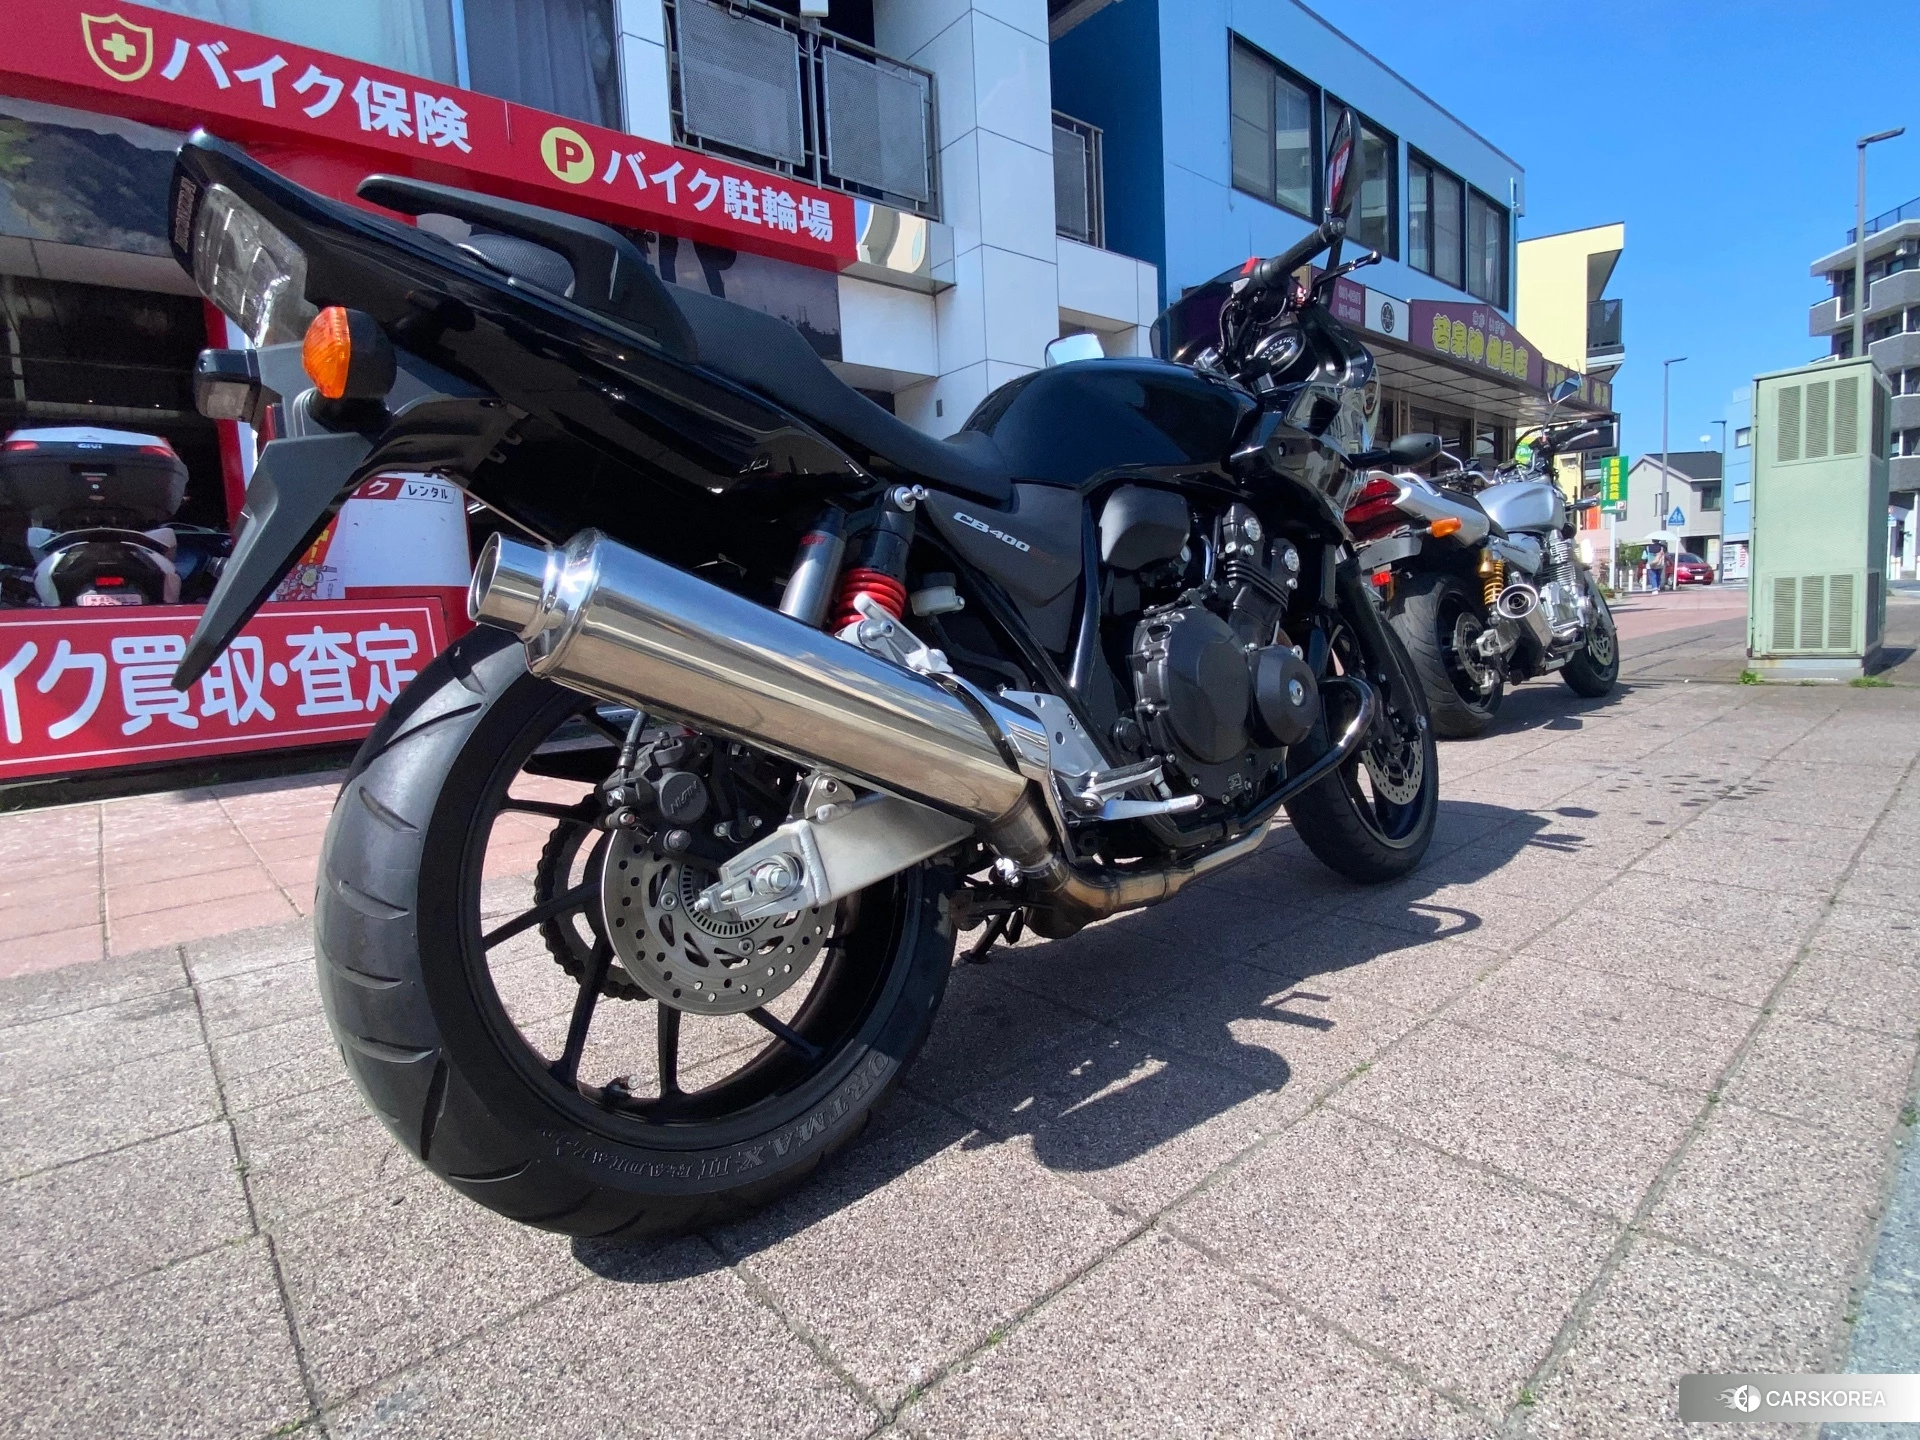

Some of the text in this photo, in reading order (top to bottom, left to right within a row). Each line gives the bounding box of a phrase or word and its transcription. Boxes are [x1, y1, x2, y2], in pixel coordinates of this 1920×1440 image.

[161, 37, 473, 155] バイク保険
[602, 149, 833, 243] バイク駐輪場
[77, 442, 103, 450] GIVI
[408, 483, 449, 500] レンタル
[952, 511, 1031, 553] CB400
[1739, 545, 1747, 568] KIRIN
